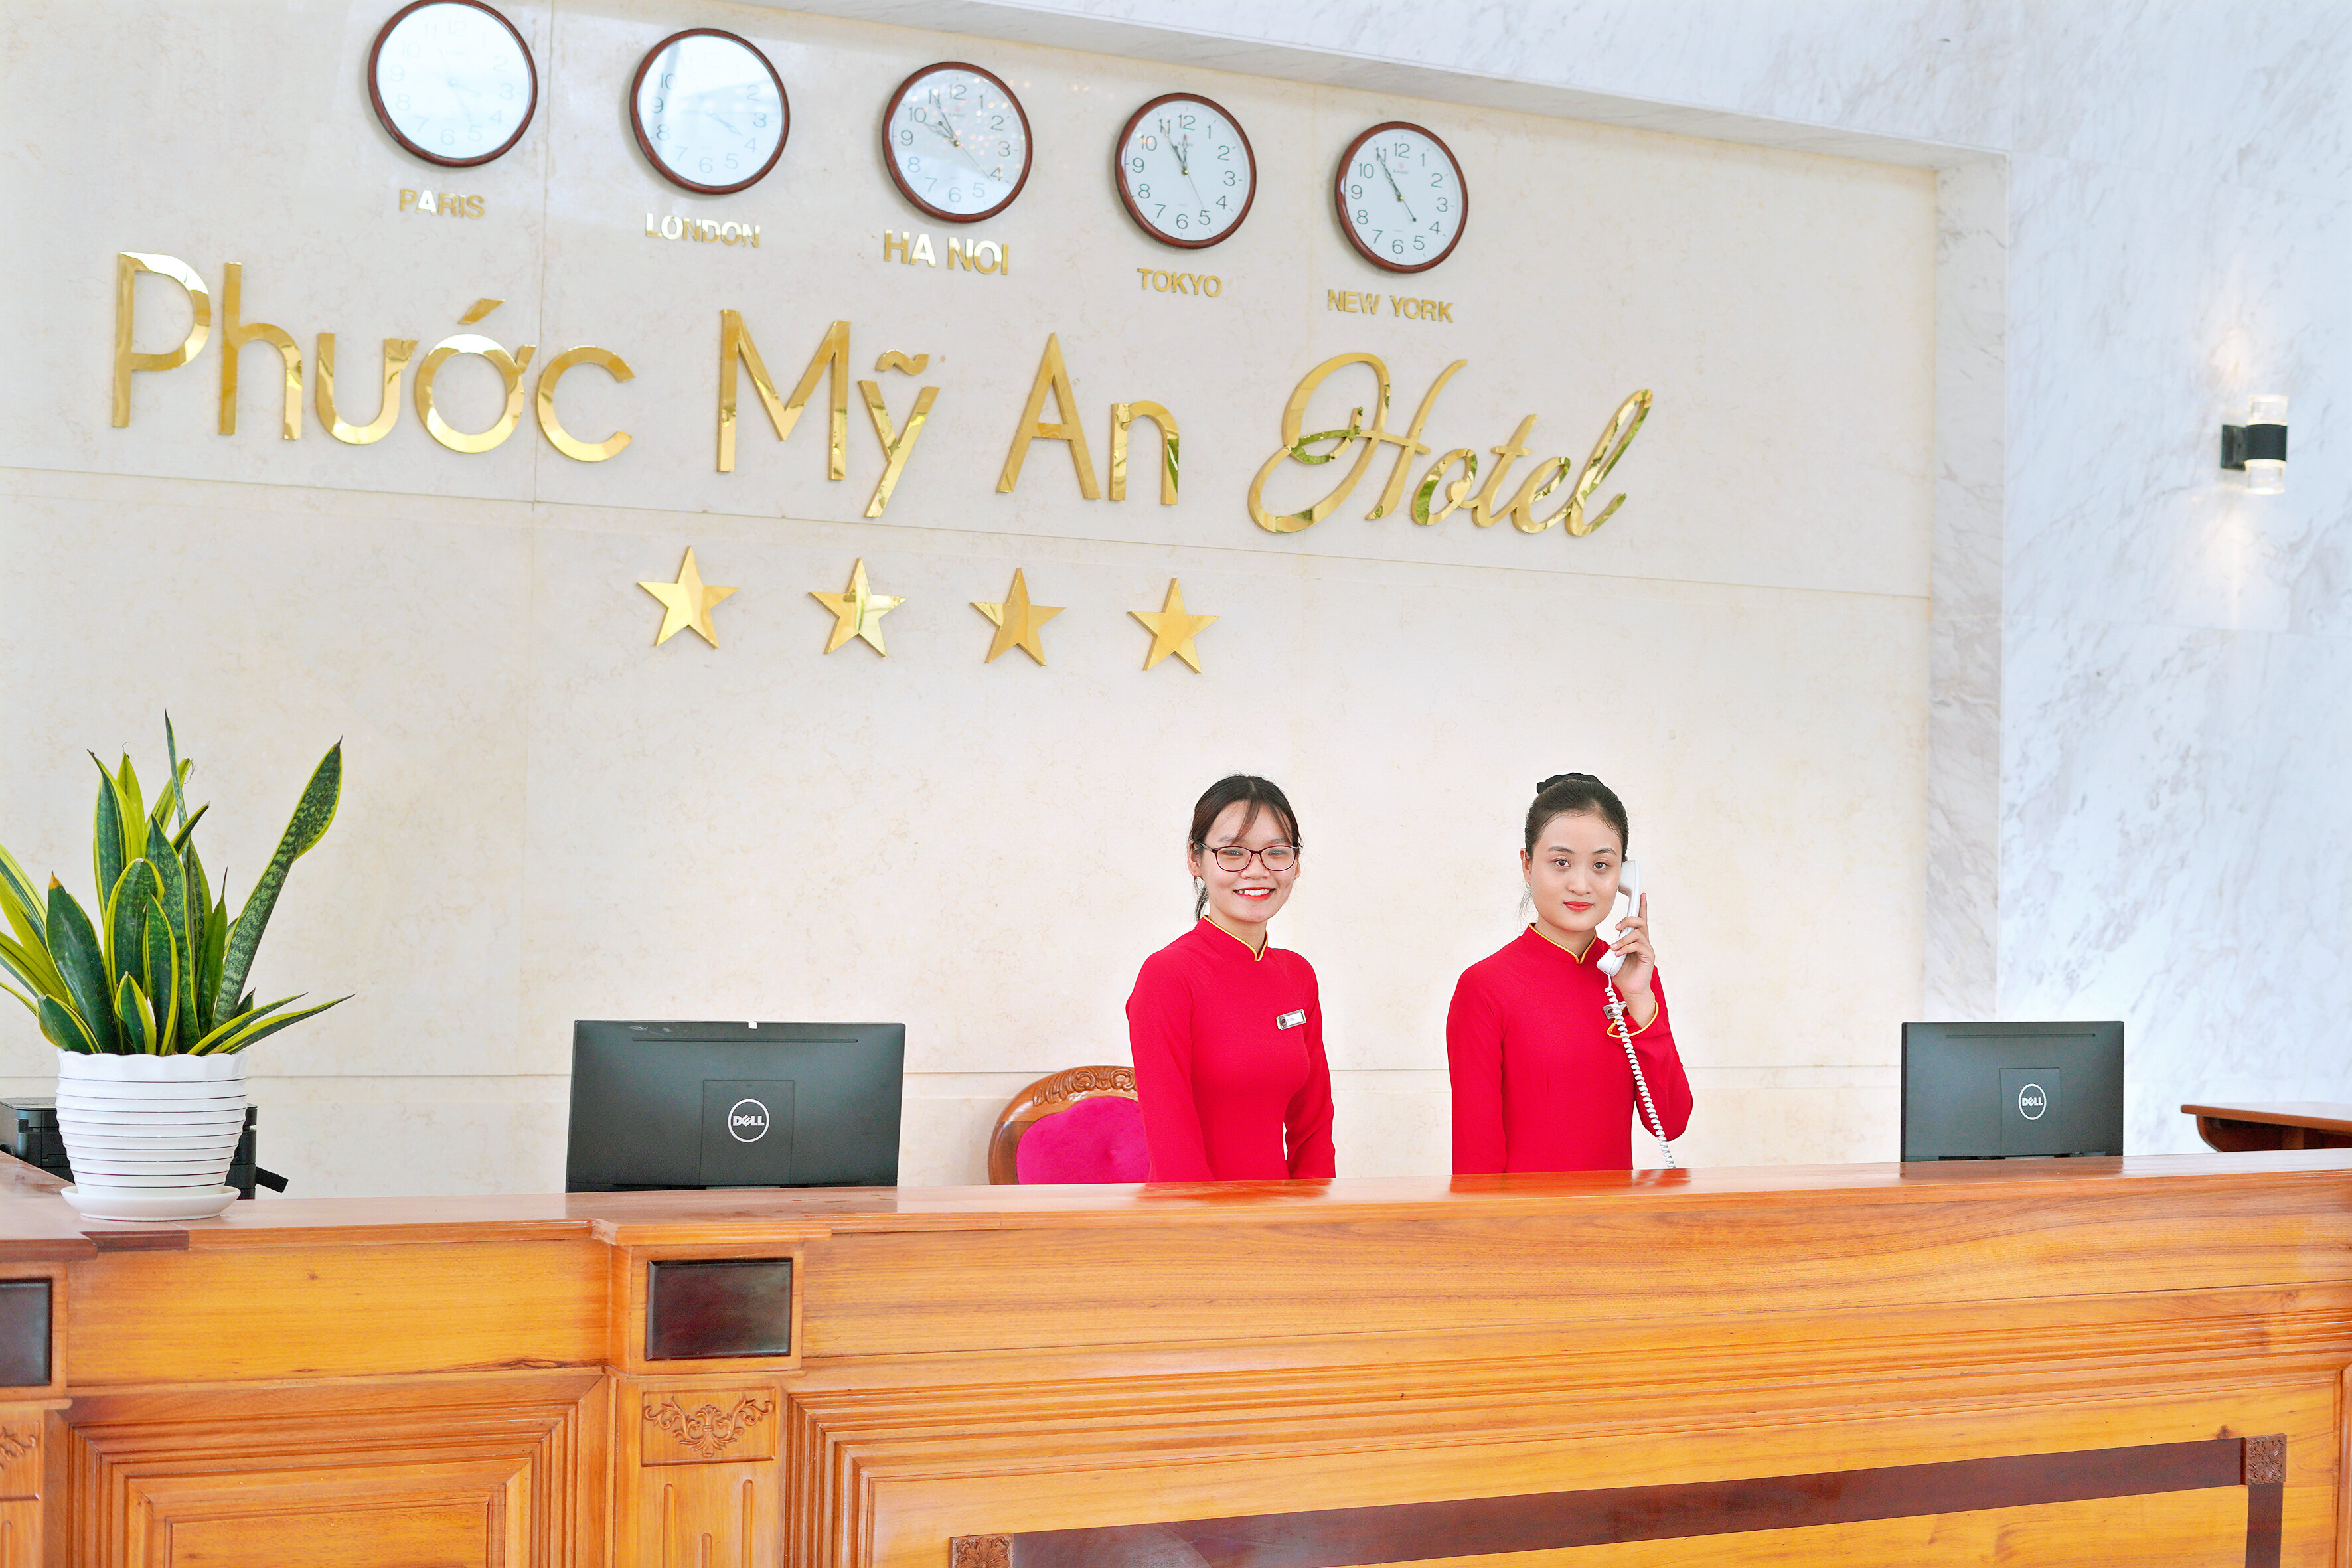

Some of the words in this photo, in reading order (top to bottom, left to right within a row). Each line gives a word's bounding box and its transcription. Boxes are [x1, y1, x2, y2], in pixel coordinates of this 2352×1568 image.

[746, 84, 760, 101] 2
[949, 84, 967, 100] 12
[650, 96, 664, 114] 9
[979, 94, 984, 110] 1
[752, 112, 767, 128] 3
[908, 106, 927, 123] 10
[1178, 114, 1196, 131] 12
[990, 115, 1004, 131] 2
[1158, 118, 1171, 134] 11
[656, 123, 670, 141] 8
[900, 129, 913, 146] 9
[1206, 125, 1211, 139] 1
[744, 137, 757, 153] 4
[997, 141, 1010, 157] 3
[1140, 135, 1157, 151] 10
[1394, 143, 1410, 159] 12
[674, 145, 688, 161] 7
[724, 153, 738, 169] 5
[1217, 145, 1230, 161] 2
[1375, 147, 1387, 162] 11
[1421, 153, 1425, 167] 1
[699, 157, 713, 173] 6
[907, 156, 921, 173] 8
[1132, 157, 1144, 173] 9
[1358, 163, 1374, 179] 10
[990, 167, 1003, 181] 4
[1223, 171, 1235, 186] 3
[1431, 173, 1443, 188] 2
[925, 177, 938, 193] 7
[972, 182, 985, 198] 5
[1138, 183, 1150, 199] 8
[1351, 185, 1362, 200] 9
[948, 187, 962, 203] 6
[1216, 195, 1227, 210] 4
[399, 188, 485, 219] PARIS
[1154, 203, 1166, 218] 7
[1436, 197, 1448, 212] 3
[1176, 214, 1188, 229] 6
[1198, 210, 1211, 225] 5
[1356, 210, 1368, 225] 8
[645, 213, 761, 248] LONDON
[1429, 221, 1441, 235] 4
[1372, 229, 1383, 244] 7
[1413, 235, 1425, 250] 5
[884, 229, 937, 267] HA
[947, 237, 1009, 275] NOI
[1392, 239, 1404, 254] 6
[1137, 268, 1222, 297] TOKYO
[1328, 289, 1381, 315] NEW
[1389, 295, 1454, 323] YORK
[112, 250, 636, 463] Phước
[716, 309, 940, 518] Mỹ
[996, 332, 1180, 505] An
[1247, 352, 1653, 536] Hotel
[2021, 1097, 2043, 1107] DELL
[732, 1115, 765, 1127] DELL
